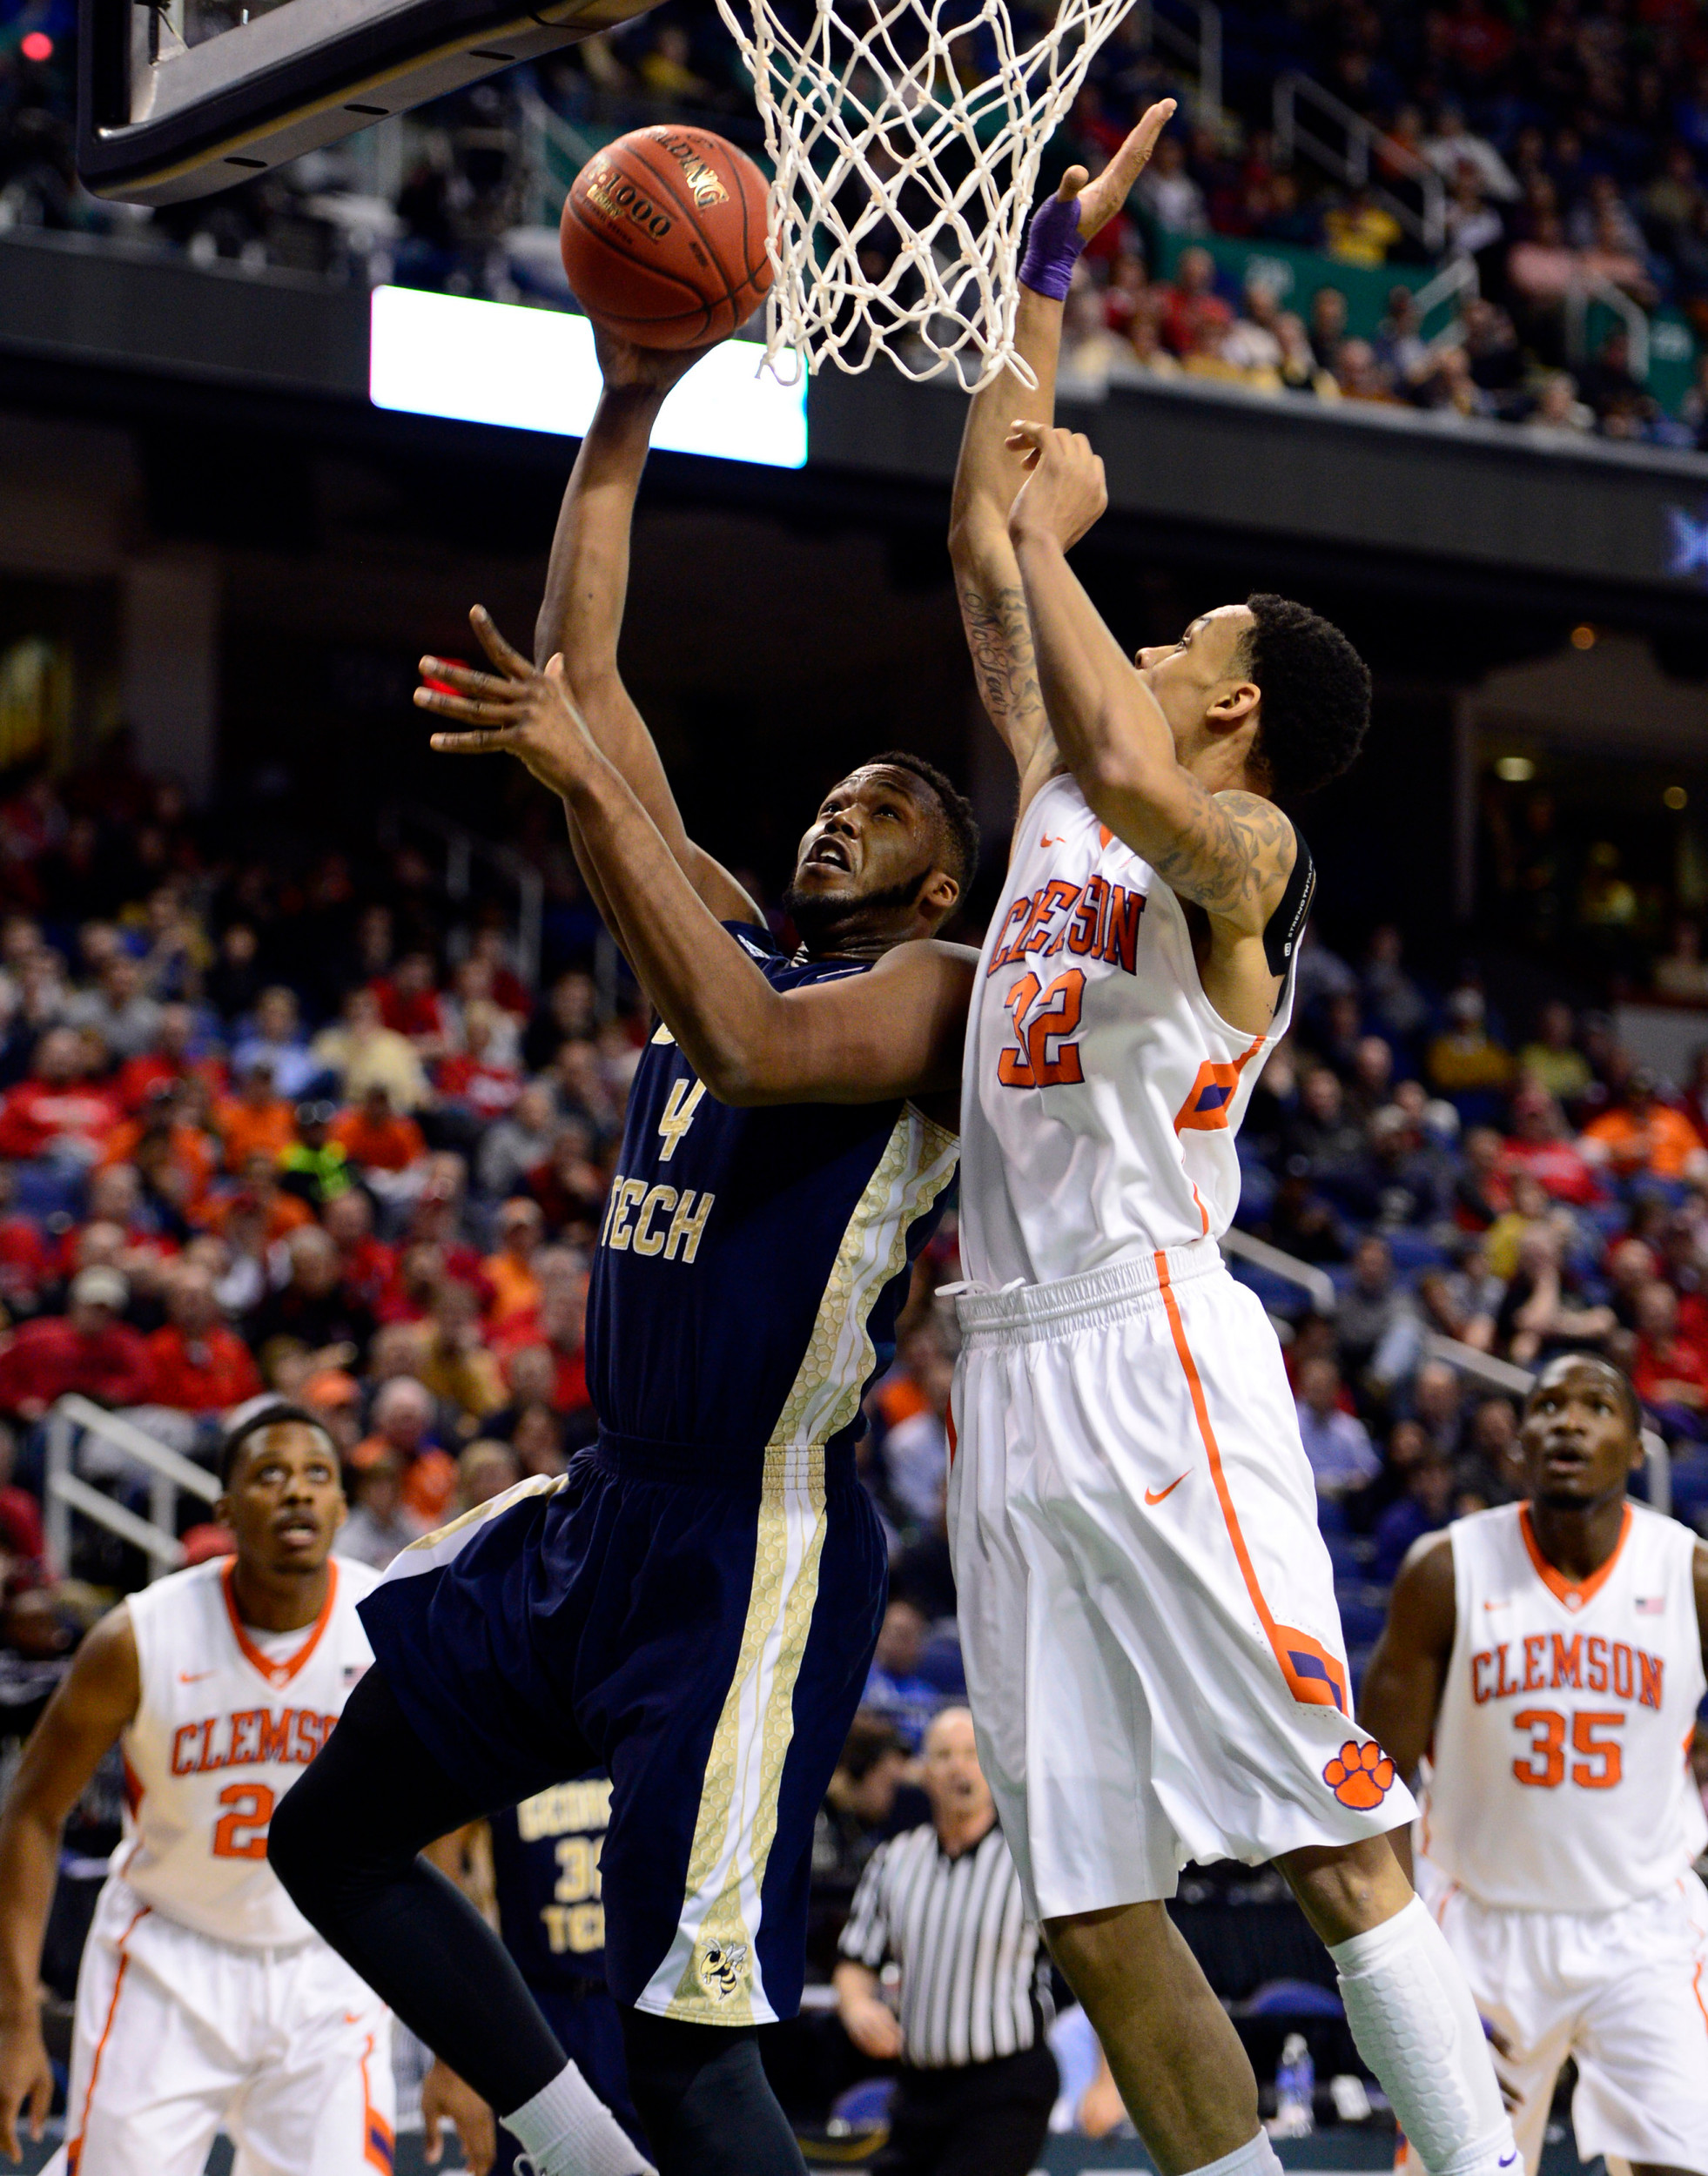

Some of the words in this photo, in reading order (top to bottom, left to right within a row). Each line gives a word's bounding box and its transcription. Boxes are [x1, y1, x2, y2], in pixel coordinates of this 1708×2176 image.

[580, 155, 672, 239] -1000
[653, 126, 730, 210] ALDING
[997, 967, 1087, 1089] 32
[658, 1078, 707, 1162] 4
[1471, 1632, 1664, 1711] CLEMSON
[1512, 1709, 1625, 1790] 35
[212, 1783, 275, 1860] 2
